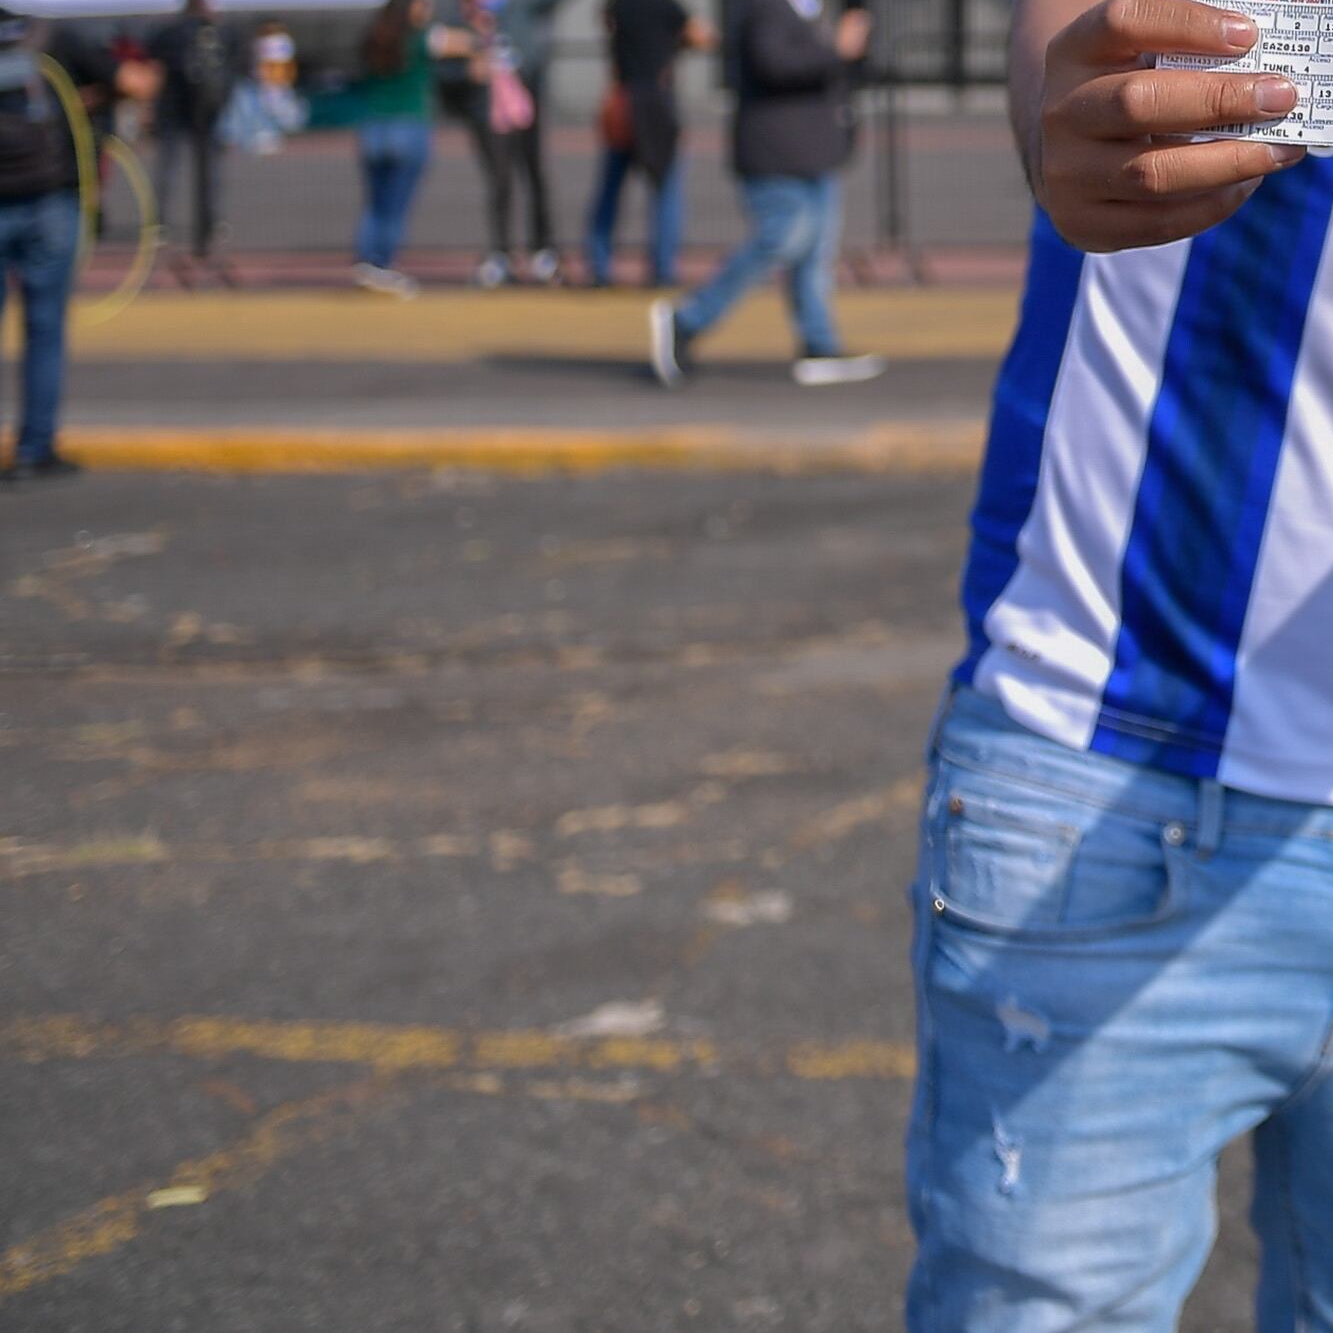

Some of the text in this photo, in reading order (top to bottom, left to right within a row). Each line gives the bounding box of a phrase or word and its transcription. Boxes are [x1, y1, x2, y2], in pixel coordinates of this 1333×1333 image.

[1294, 22, 1301, 30] 2
[1262, 42, 1310, 52] EAZ0130
[1263, 63, 1296, 73] TUNEL
[1319, 90, 1332, 98] 13
[1255, 127, 1302, 138] TUNEL 4
